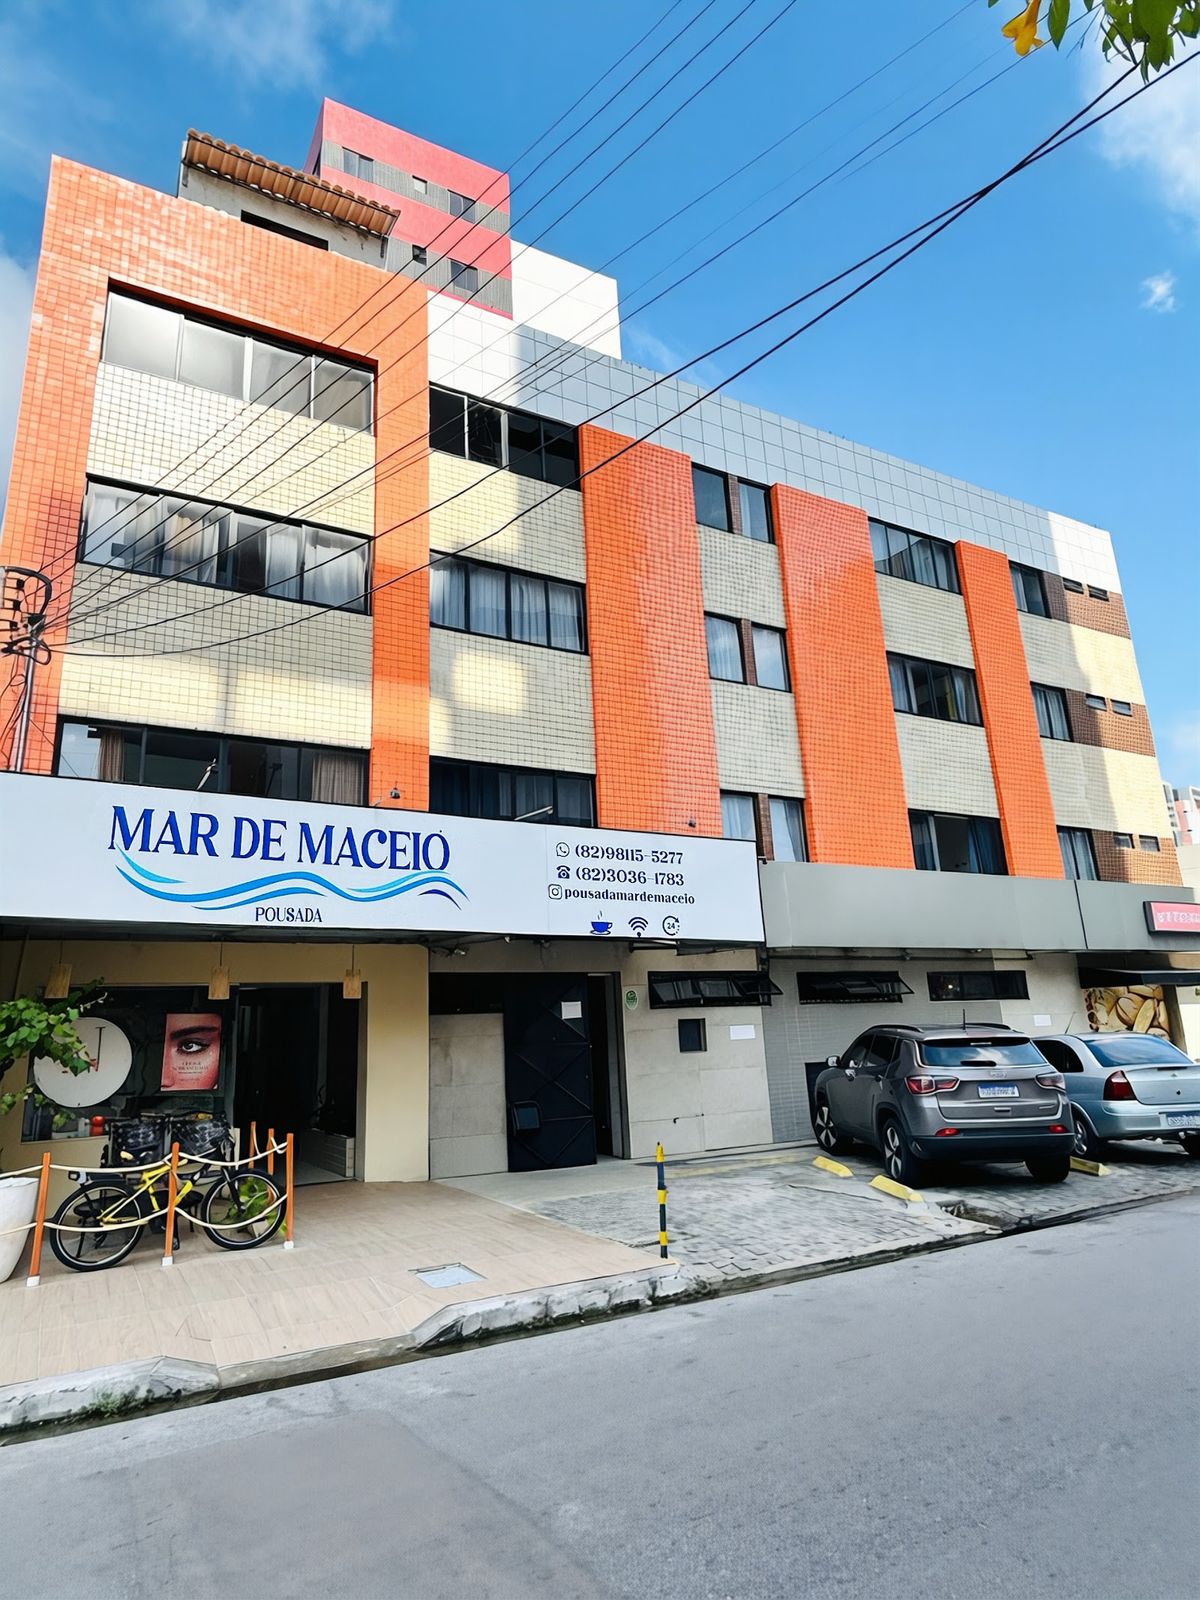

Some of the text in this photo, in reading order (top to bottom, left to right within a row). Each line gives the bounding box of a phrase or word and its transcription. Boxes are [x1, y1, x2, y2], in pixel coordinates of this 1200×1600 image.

[108, 805, 219, 857] MAR
[231, 816, 287, 861] DE
[575, 843, 683, 864] (82)98115-5277
[576, 866, 684, 886] (82)3036-1783
[564, 887, 695, 904] pousadamardemaceio
[255, 906, 323, 923] POUSADA
